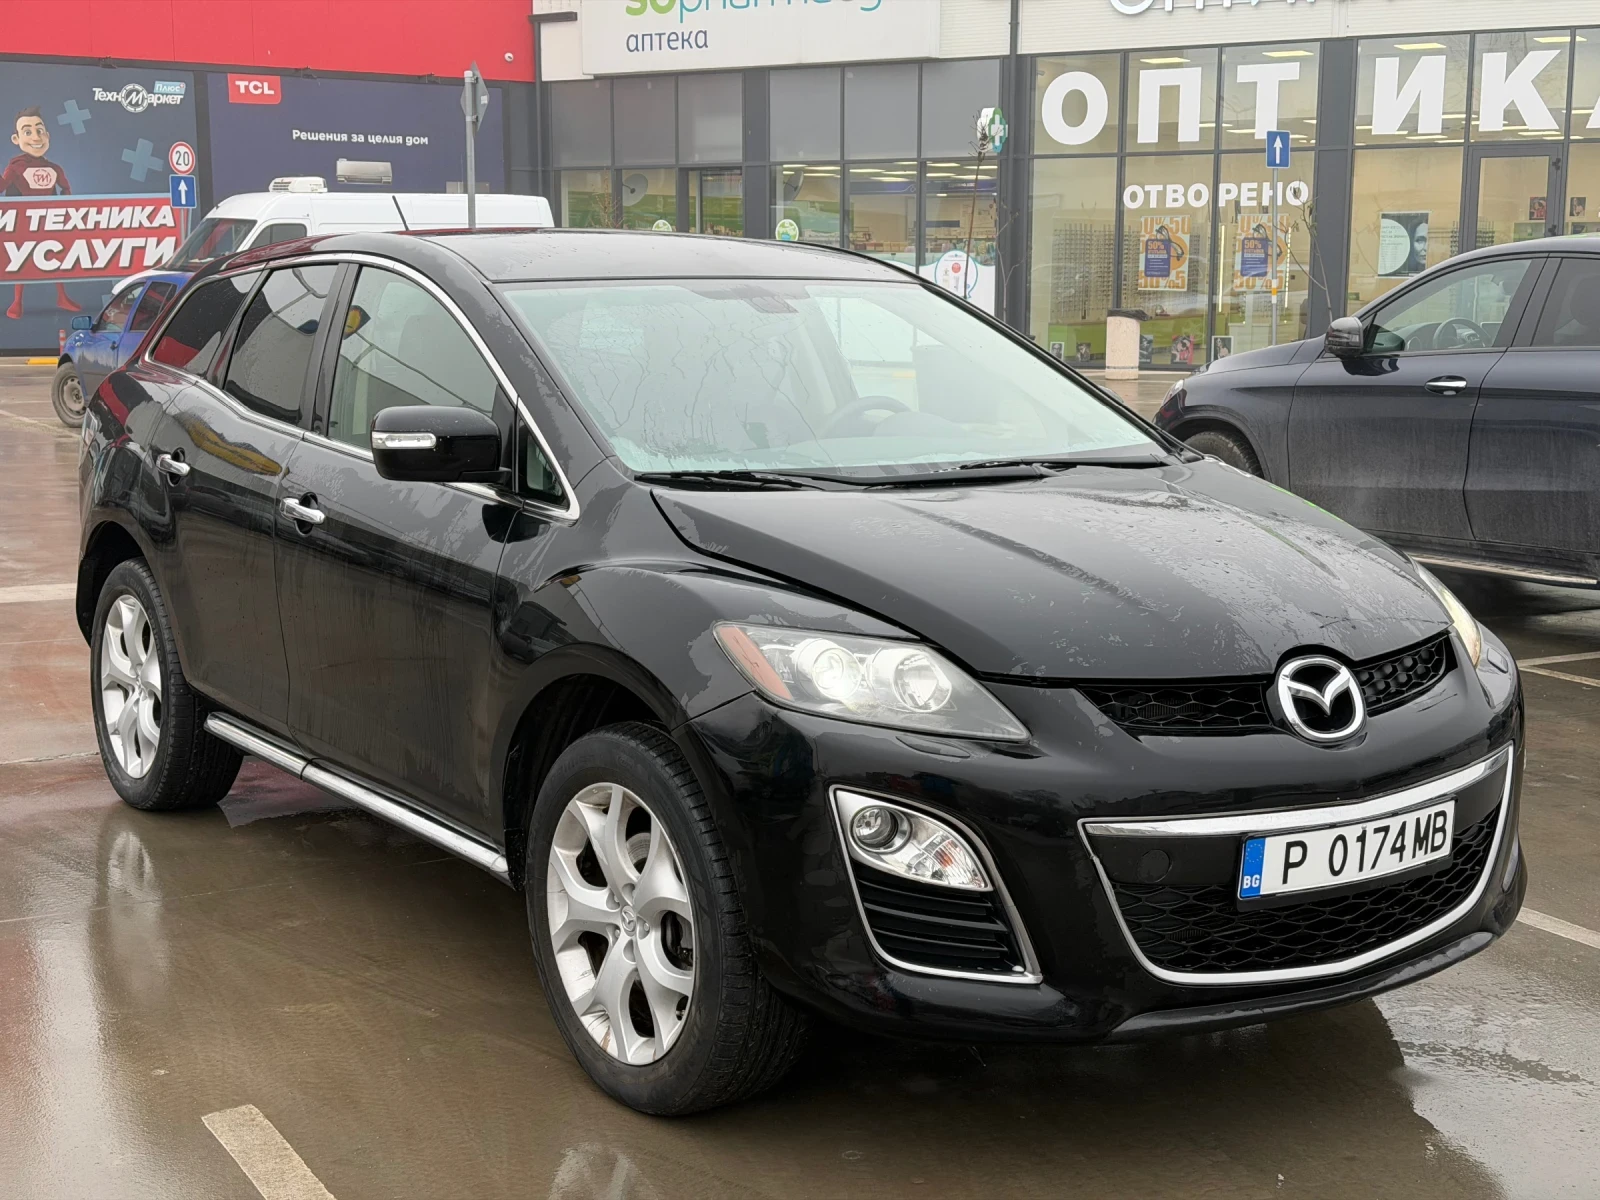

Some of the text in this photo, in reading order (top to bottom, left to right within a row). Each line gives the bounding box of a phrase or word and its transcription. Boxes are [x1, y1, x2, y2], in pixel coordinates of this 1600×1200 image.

[626, 29, 708, 52] аптека
[235, 81, 275, 95] TCL
[1042, 50, 1600, 145] ОПТИК
[292, 129, 429, 146] Решения за целия дом
[175, 150, 190, 166] 20
[26, 205, 175, 232] ТЕХНИКА
[4, 236, 176, 272] УСЛУГИ
[1282, 840, 1308, 885] P
[1242, 874, 1261, 889] BG
